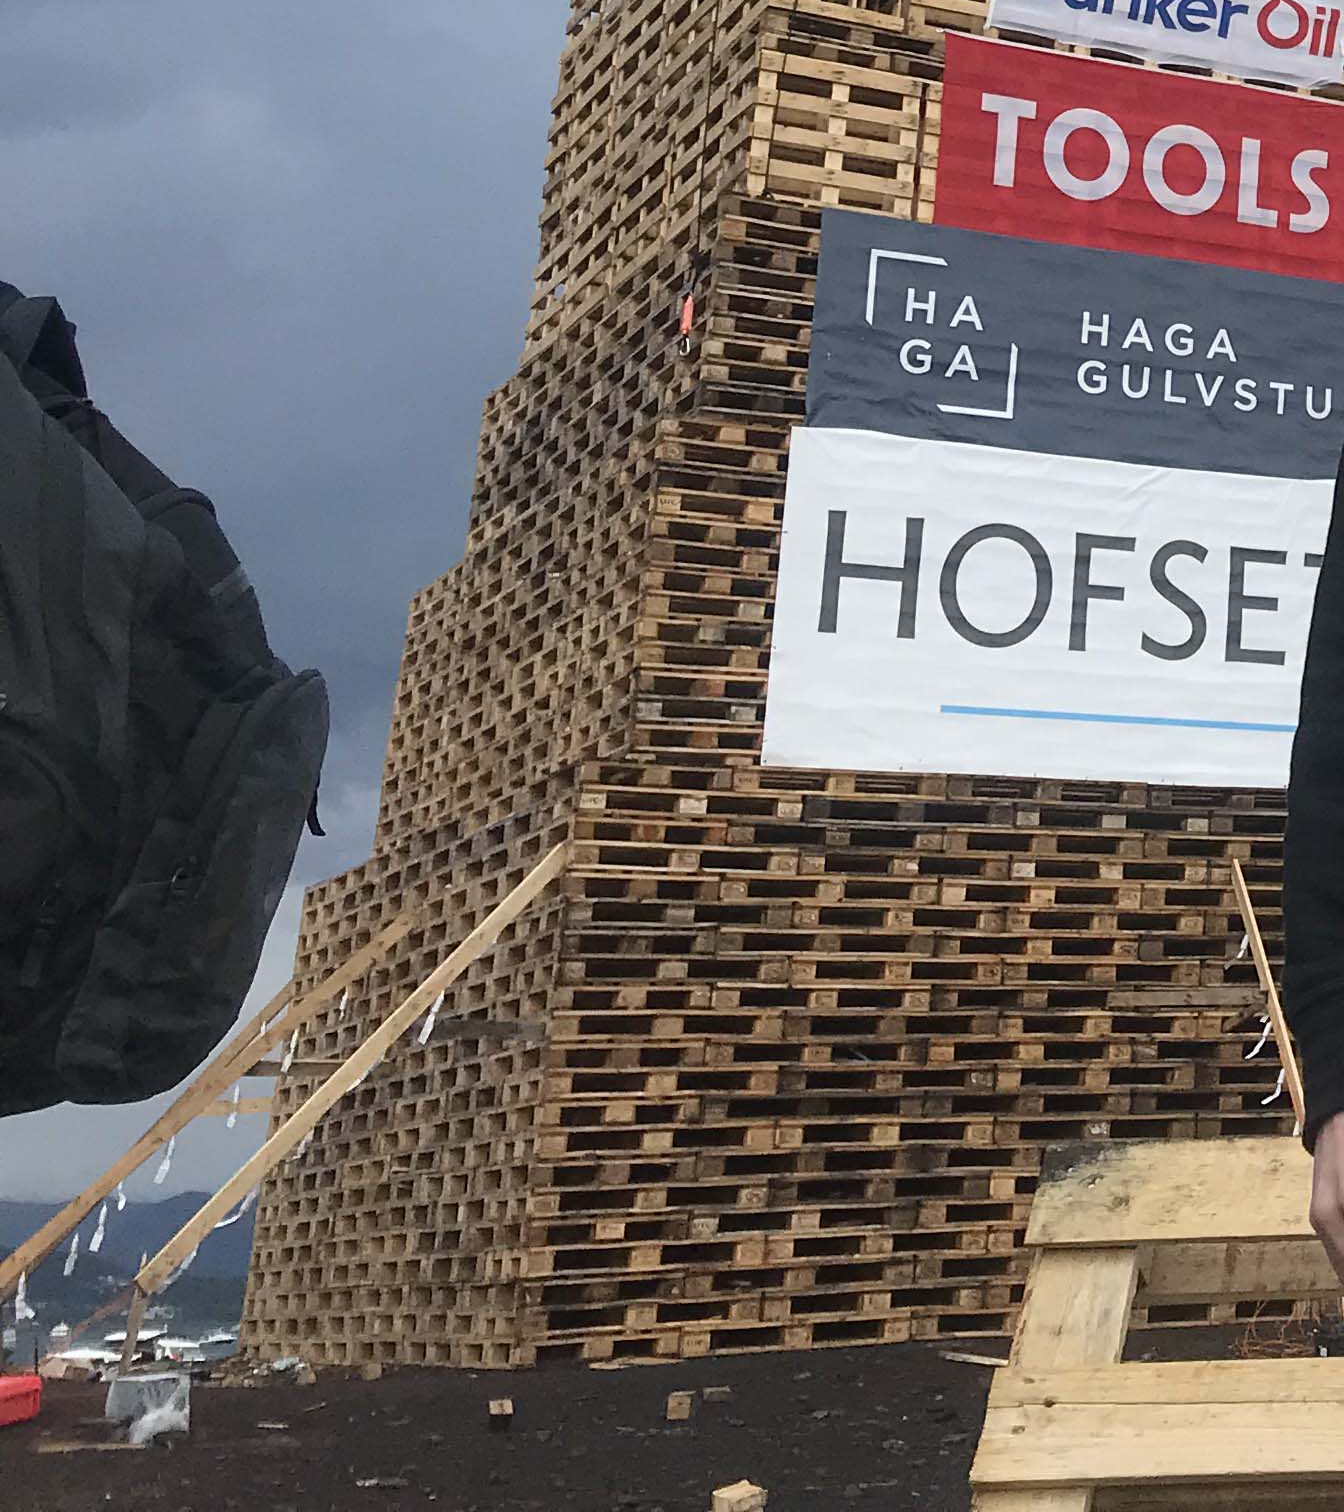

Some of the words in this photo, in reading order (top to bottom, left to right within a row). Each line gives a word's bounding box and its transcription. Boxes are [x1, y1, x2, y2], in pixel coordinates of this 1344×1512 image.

[980, 92, 1330, 234] TOOLS
[904, 287, 984, 331] HA
[899, 338, 980, 381] GA
[1080, 311, 1238, 363] HAGA
[816, 509, 1324, 667] HOFSE
